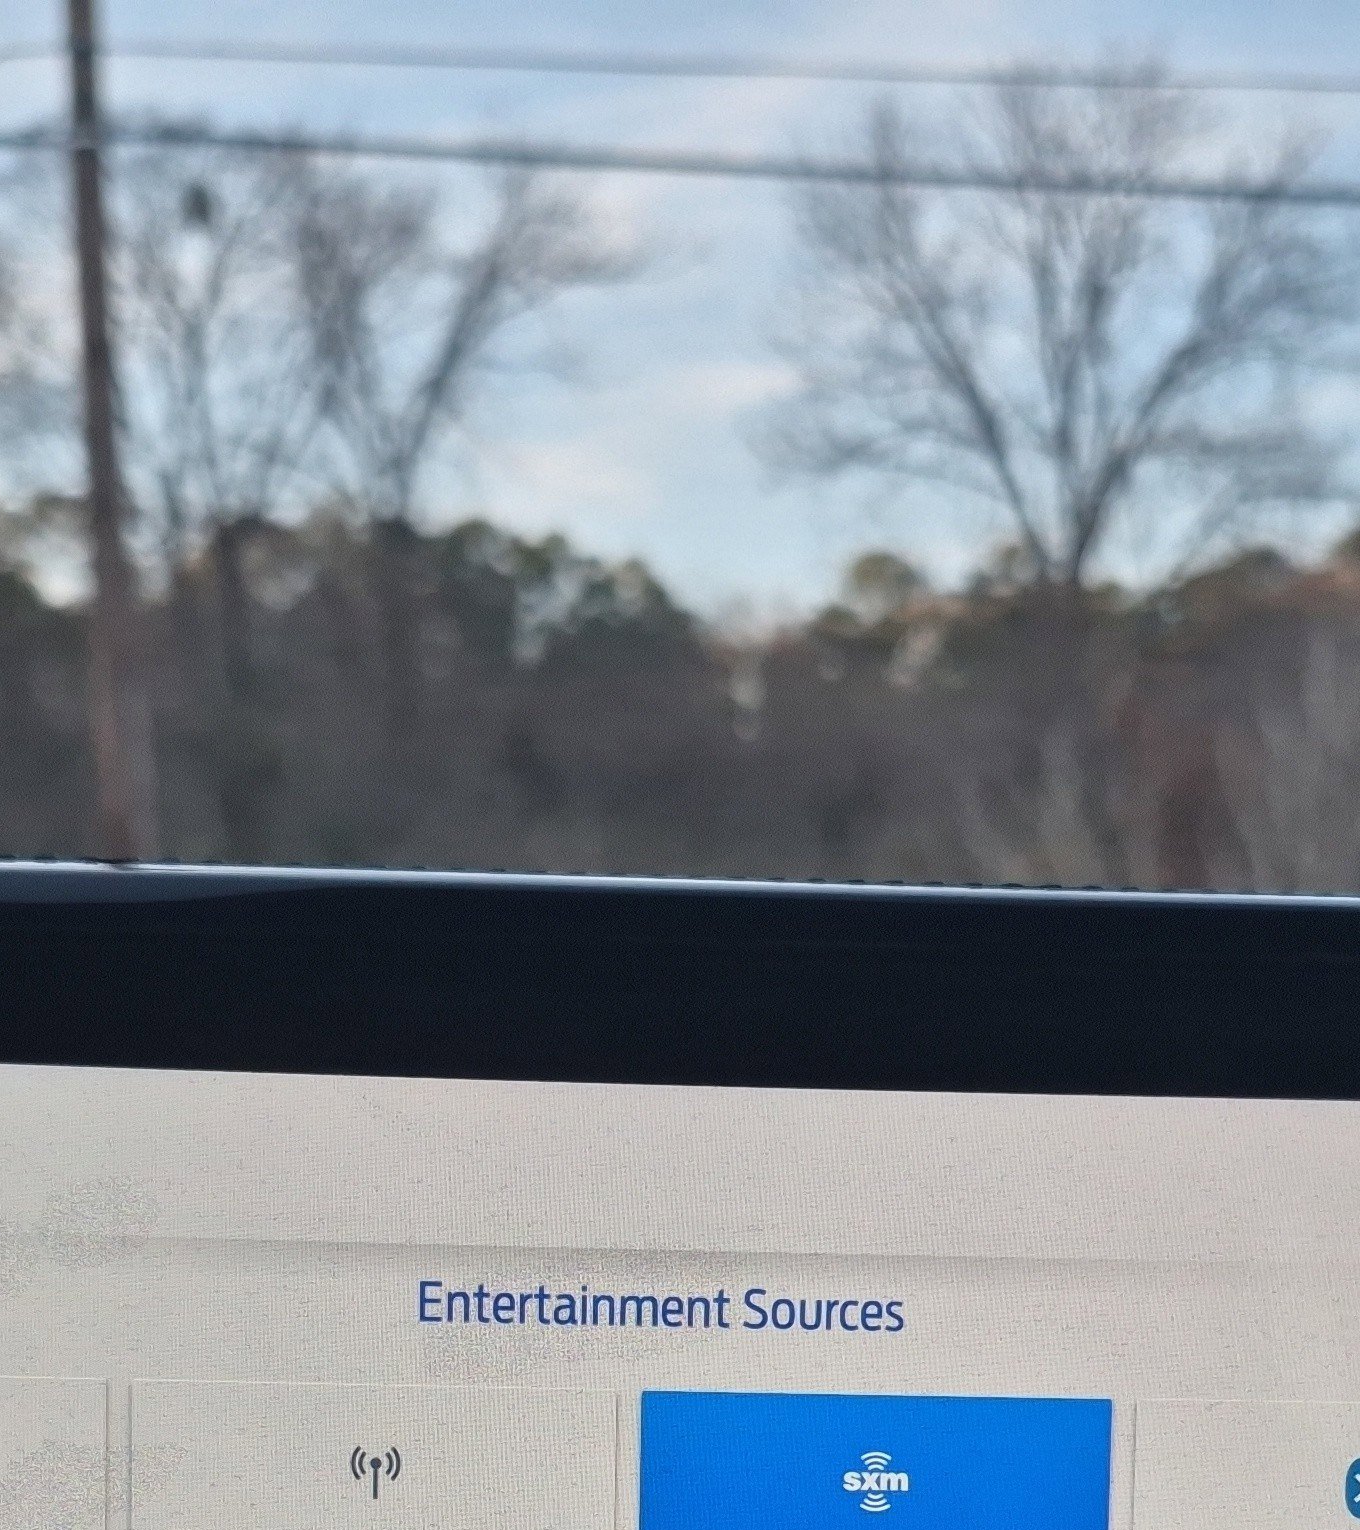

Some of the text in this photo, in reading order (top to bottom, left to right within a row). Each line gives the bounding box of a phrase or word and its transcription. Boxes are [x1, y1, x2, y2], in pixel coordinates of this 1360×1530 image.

[418, 1281, 904, 1332] Entertainment Sources
[843, 1468, 909, 1493] sxm
